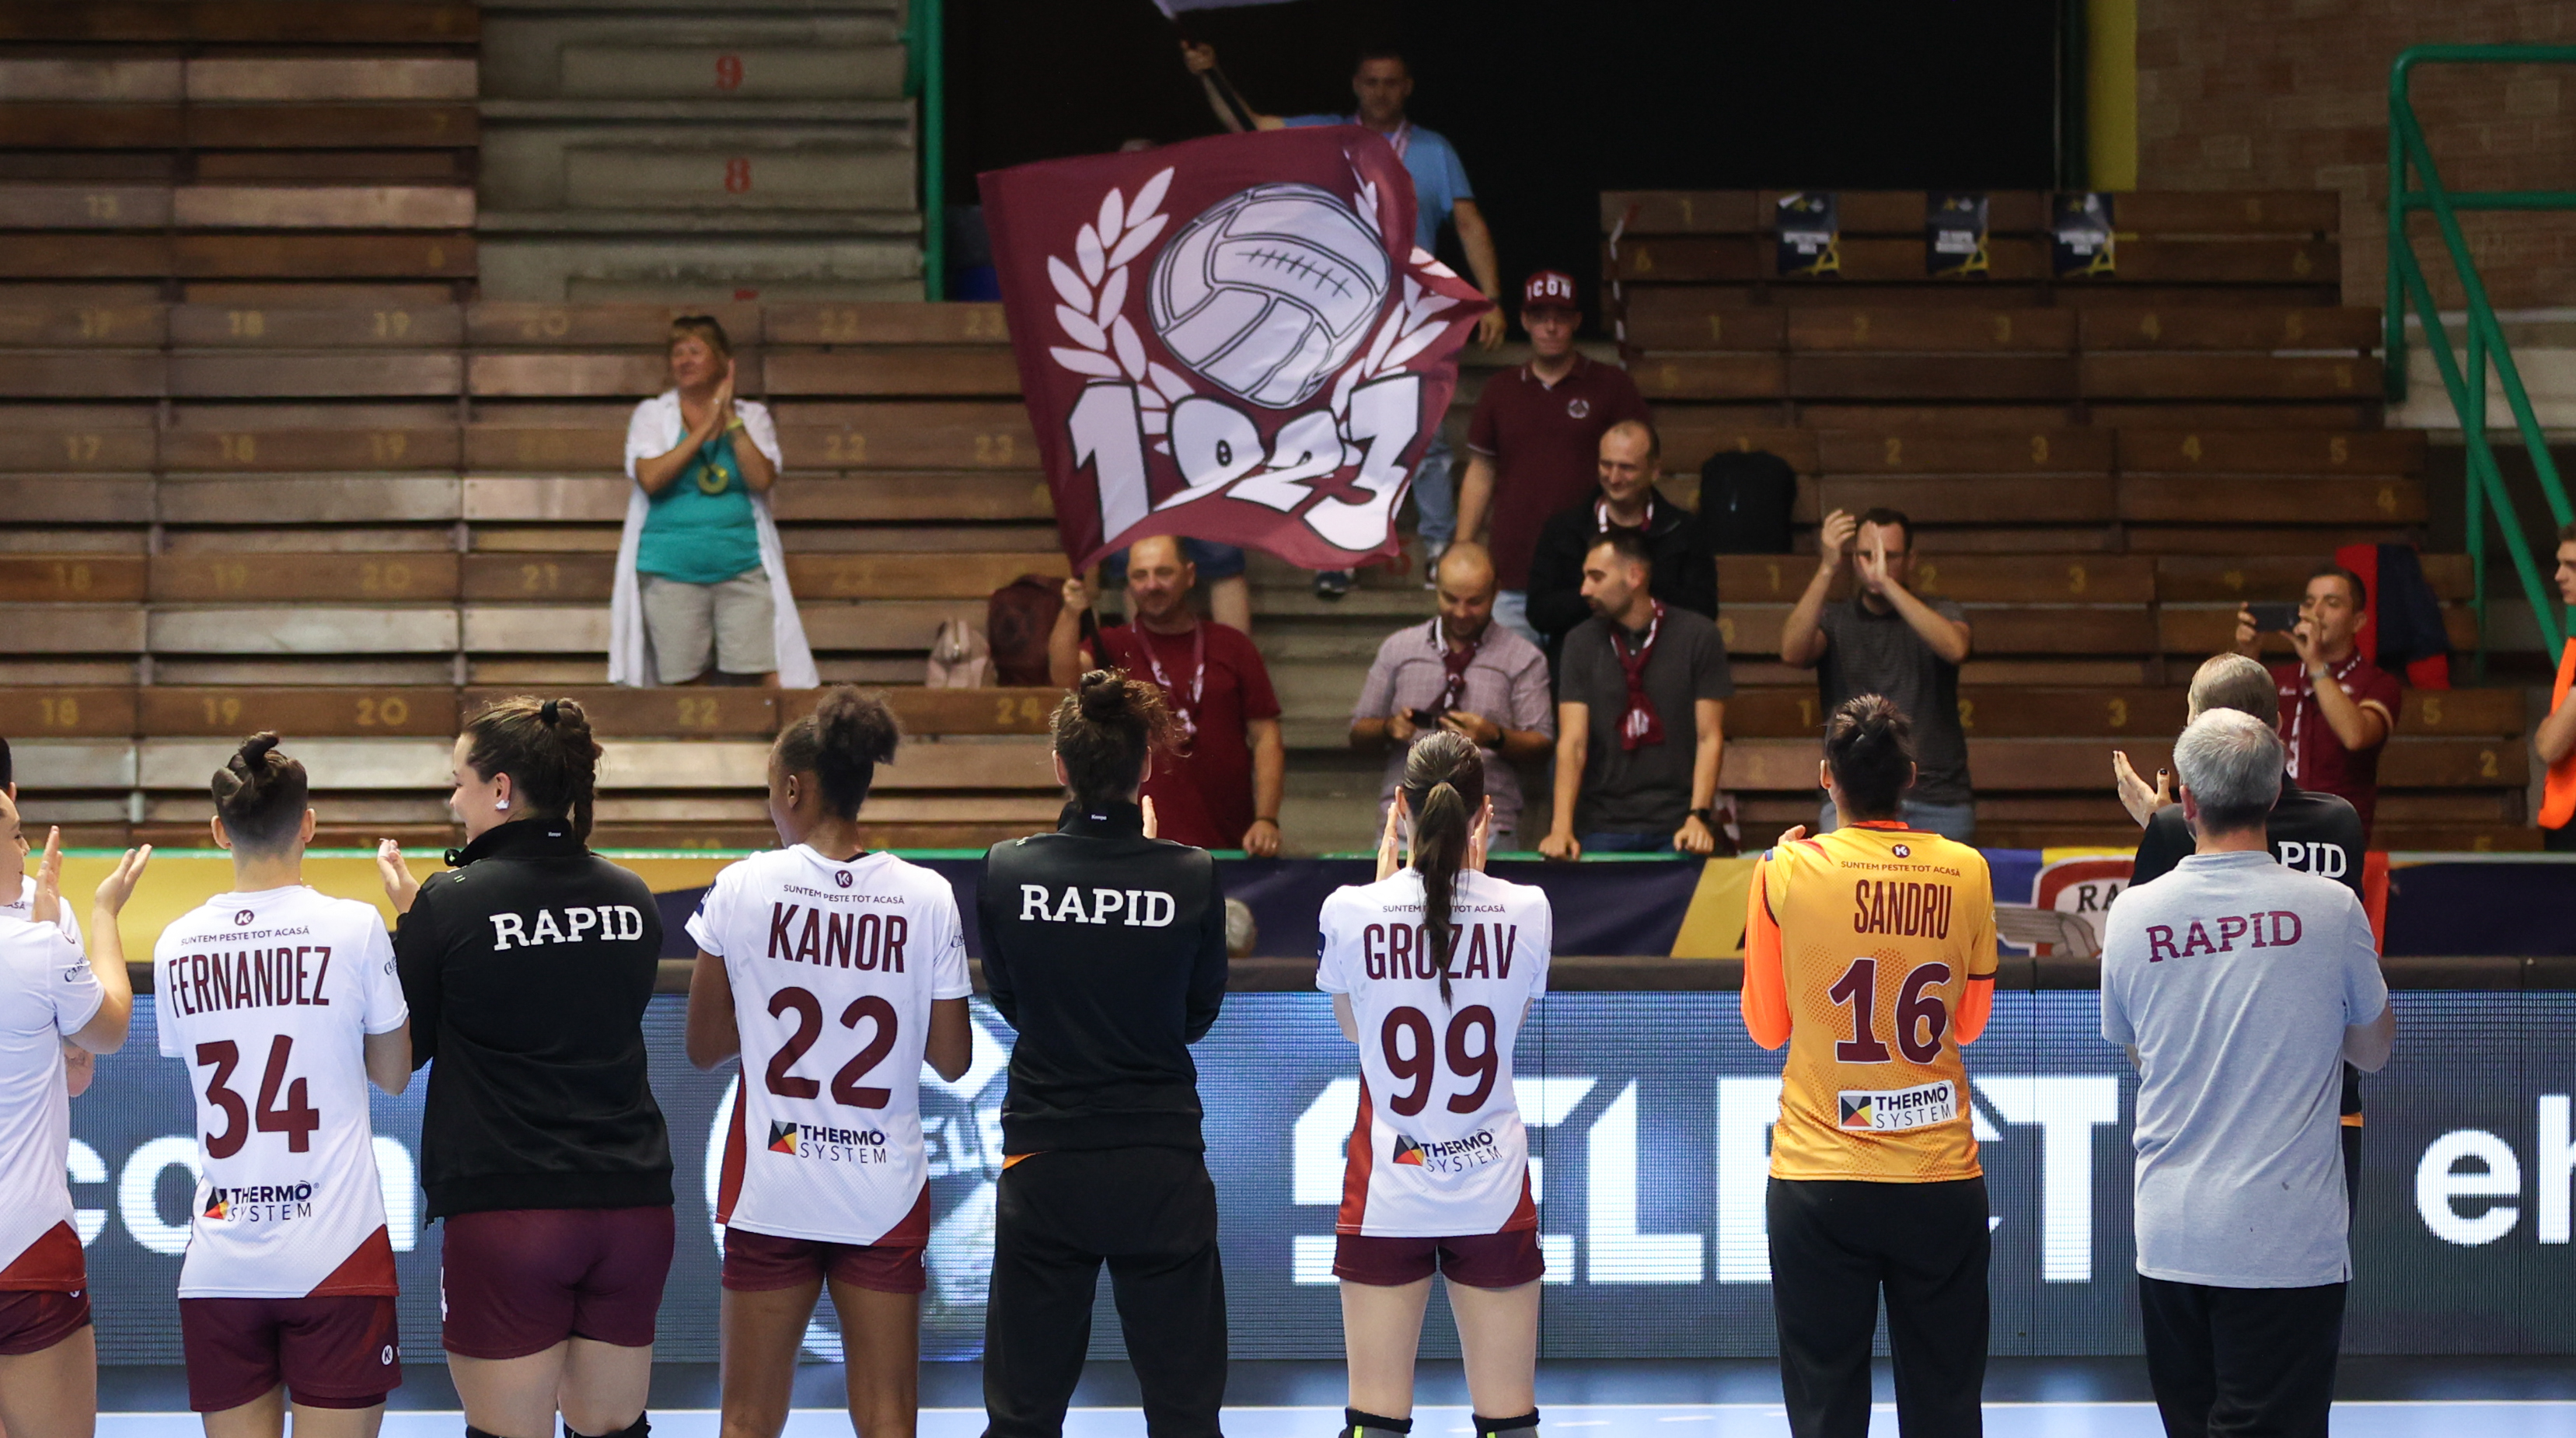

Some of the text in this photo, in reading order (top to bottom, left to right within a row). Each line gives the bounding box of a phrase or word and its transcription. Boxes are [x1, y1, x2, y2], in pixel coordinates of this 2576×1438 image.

[716, 54, 744, 91] 9
[724, 157, 752, 194] 8
[1526, 278, 1572, 302] ICON
[1068, 372, 1420, 551] 1923
[1768, 562, 1782, 591] 1
[2068, 563, 2088, 595] 3
[354, 696, 408, 727] 20
[997, 696, 1042, 726] 24
[1797, 698, 1813, 728] 1
[2107, 698, 2127, 728] 3
[1841, 860, 1880, 871] SUNTEM
[1911, 864, 1932, 873] TOT
[2277, 840, 2347, 878] PID
[784, 884, 905, 905] SUNTEM PESTE TOT ACASĂ
[1019, 883, 1176, 927] RAPID
[1474, 903, 1506, 913] ACASĂ
[1854, 878, 1953, 941] SANDRU
[180, 926, 310, 946] SUNTEM PESTE TOT ACASĂ
[489, 905, 644, 951] RAPID
[767, 901, 908, 973] KANOR
[2145, 910, 2302, 963] RAPID
[1363, 923, 1517, 980] GROZAV
[169, 946, 332, 1018] FERNANDEZ
[1827, 957, 1952, 1065] 16
[765, 986, 899, 1109] 22
[1380, 1004, 1499, 1116] 99
[195, 1035, 319, 1159] 34
[1875, 1084, 1949, 1112] THERMO
[1876, 1103, 1953, 1129] SYSTEM
[800, 1125, 886, 1147] THERMO
[1420, 1129, 1493, 1157] THERMO
[800, 1142, 886, 1164] SYSTEM
[1426, 1146, 1503, 1172] SYSTEM
[231, 1181, 312, 1205] THERMO
[228, 1202, 312, 1222] SYSTEM
